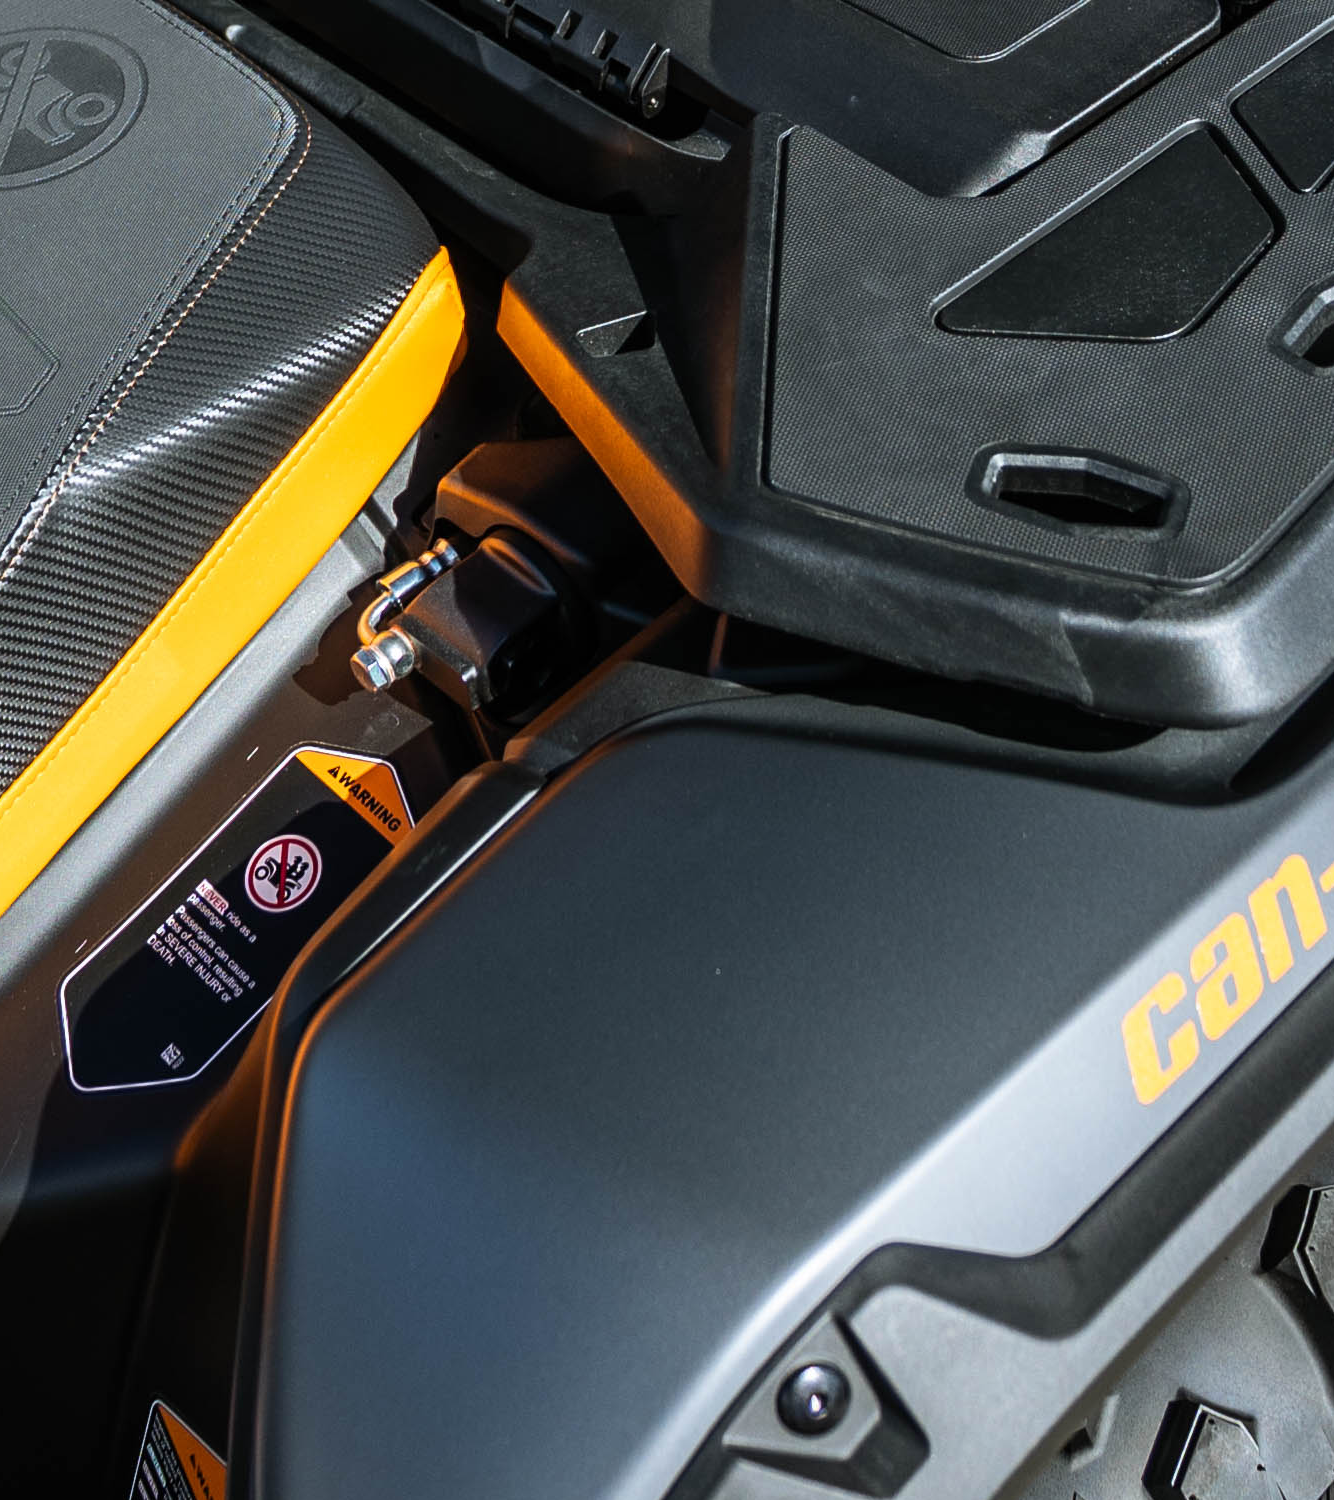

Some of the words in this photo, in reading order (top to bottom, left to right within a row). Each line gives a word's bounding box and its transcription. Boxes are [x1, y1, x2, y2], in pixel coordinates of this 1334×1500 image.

[339, 773, 401, 834] WARNING
[197, 882, 227, 913] NEVER
[224, 910, 242, 928] ride
[238, 925, 250, 937] as
[247, 934, 257, 943] a
[162, 933, 197, 967] SEVERE
[193, 963, 224, 994] INJURY
[173, 904, 218, 949] Passengers
[212, 945, 229, 962] can
[226, 959, 250, 983] cause
[246, 979, 256, 989] a
[179, 929, 192, 941] of
[210, 963, 245, 997] resulting
